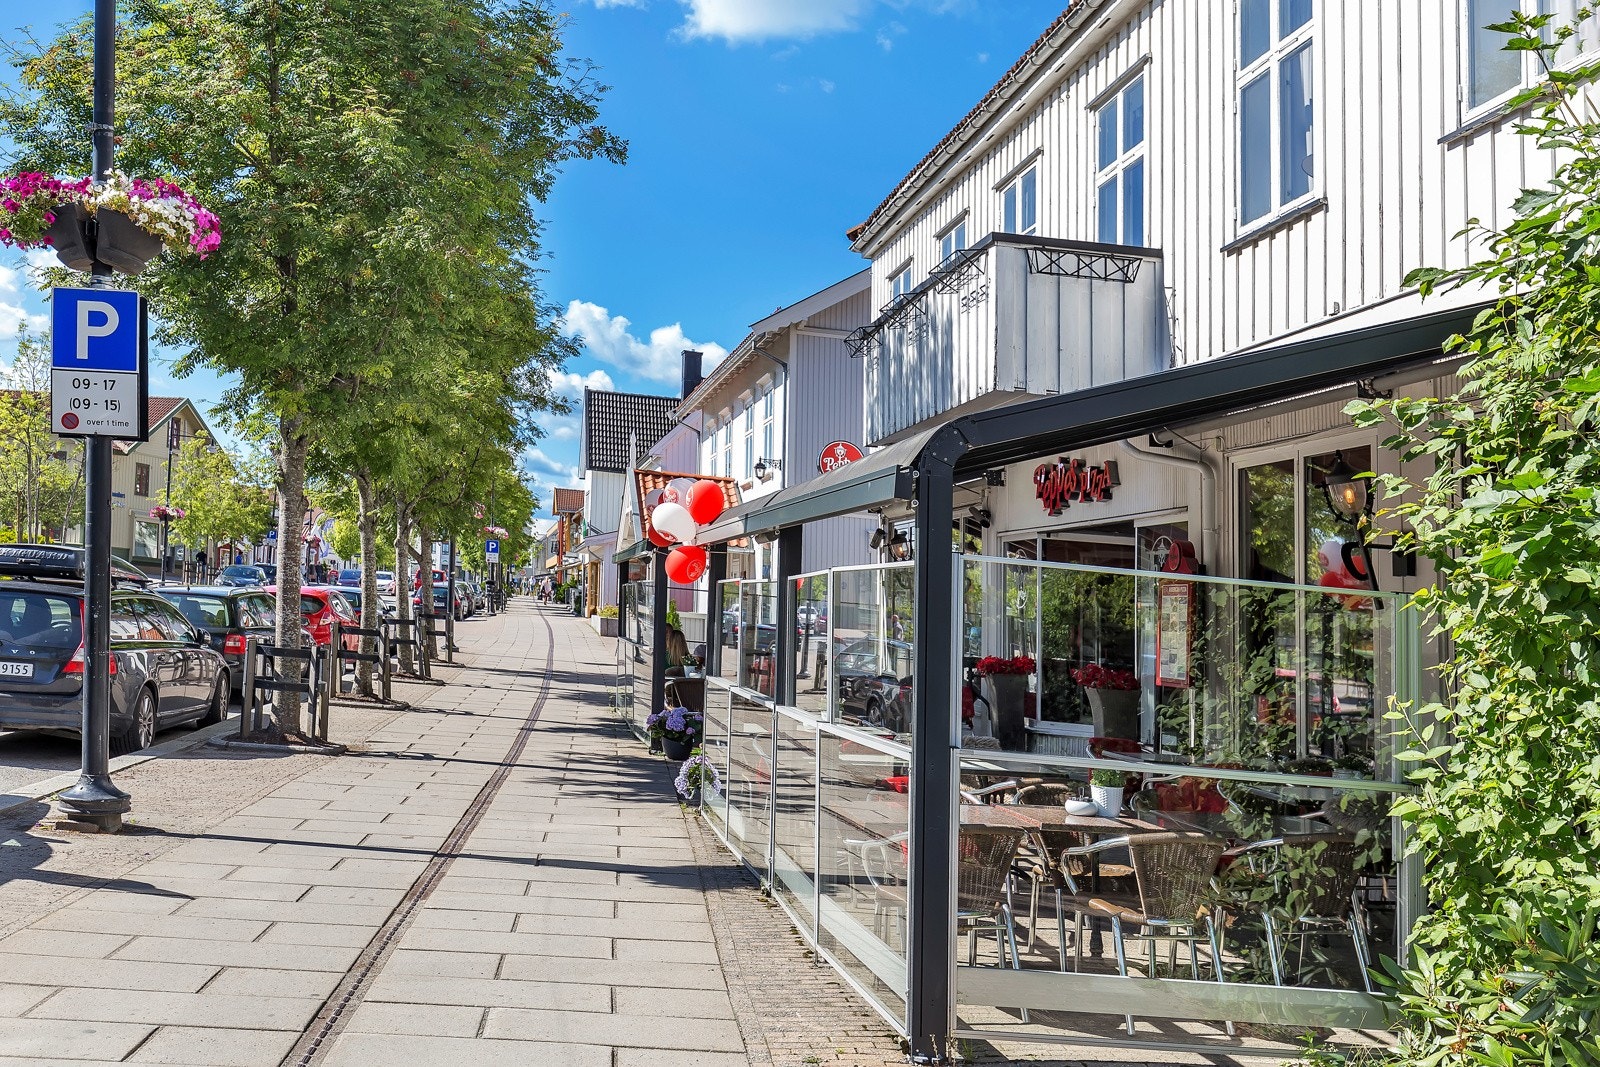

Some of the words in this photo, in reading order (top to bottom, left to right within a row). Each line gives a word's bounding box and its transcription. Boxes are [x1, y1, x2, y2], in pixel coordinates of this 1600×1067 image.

[76, 299, 120, 360] P
[86, 419, 104, 427] over
[111, 419, 130, 428] time
[489, 541, 497, 552] P
